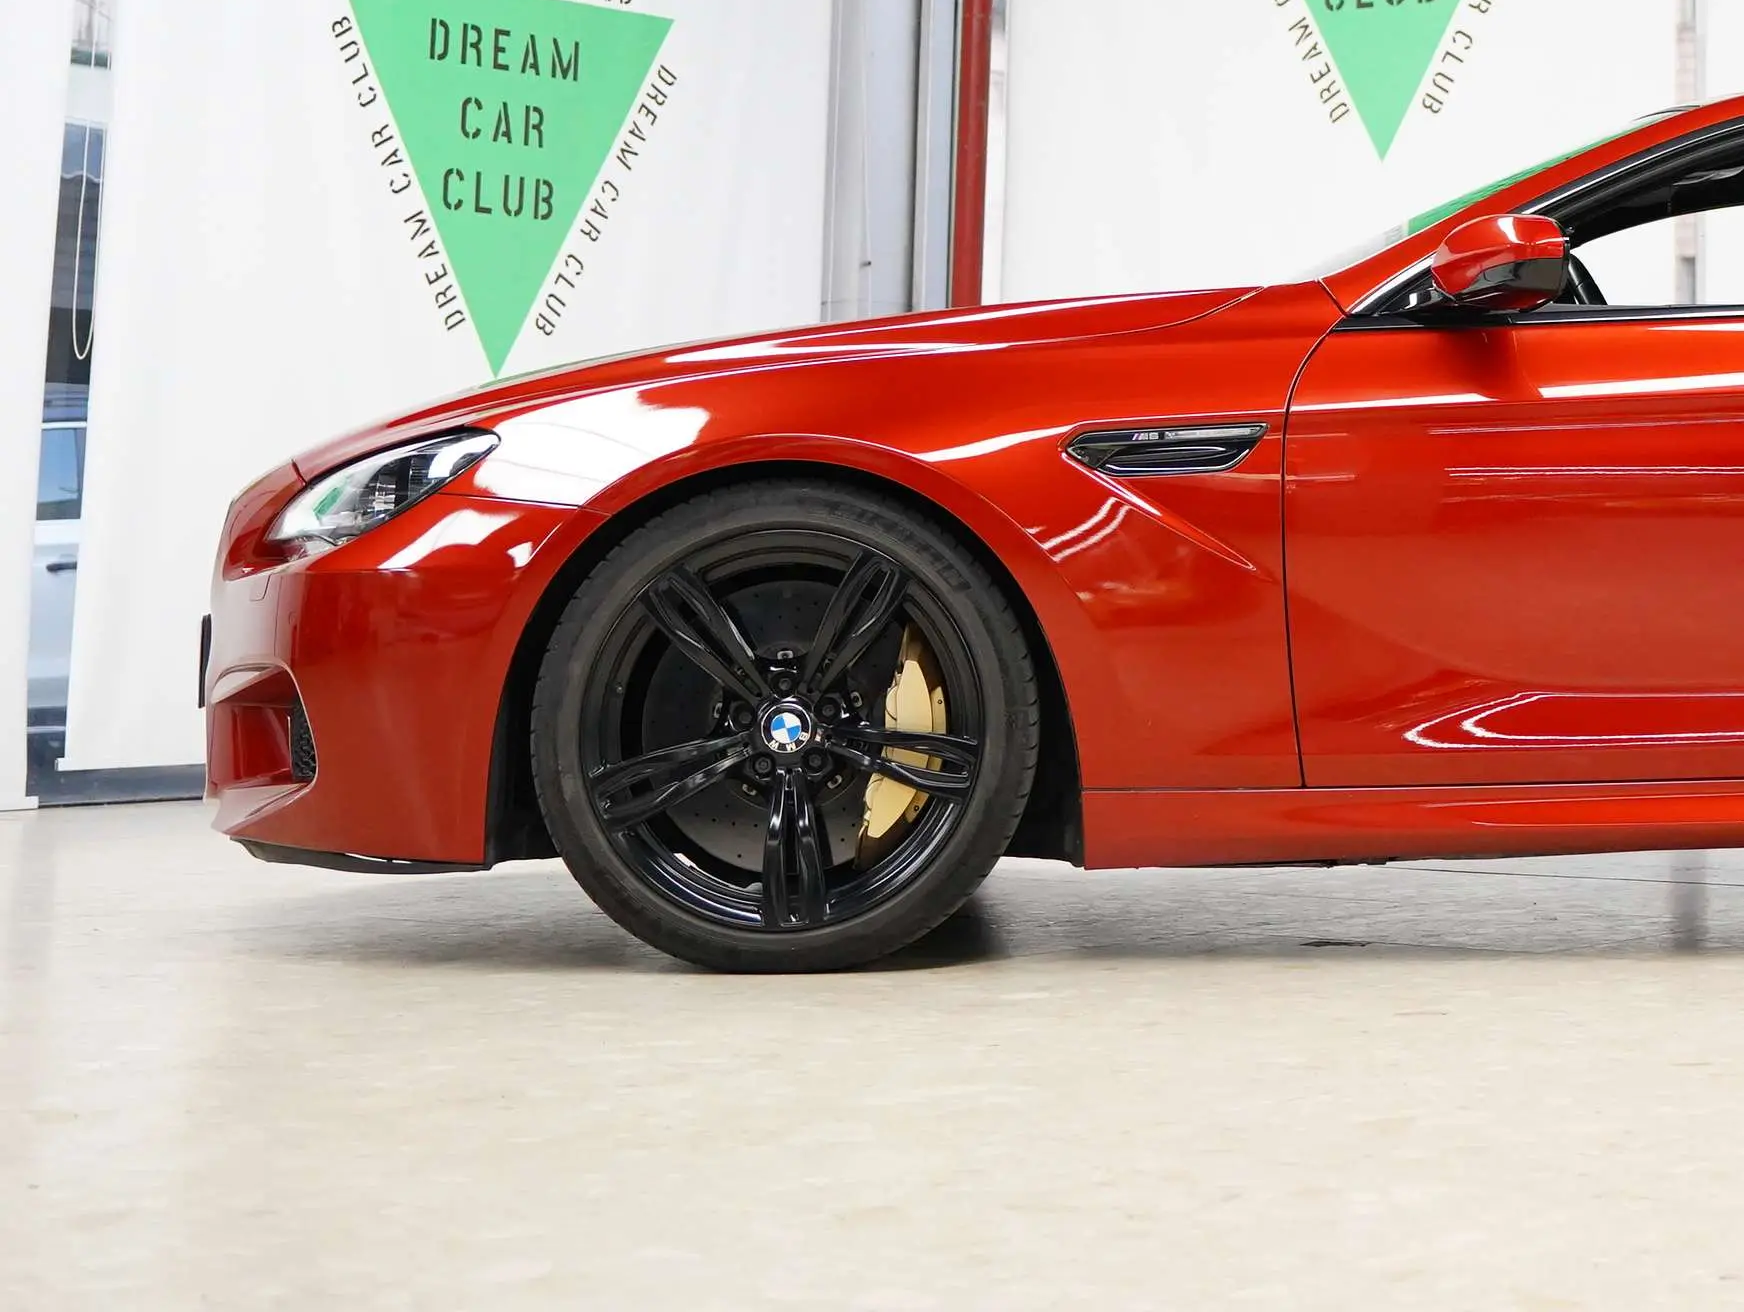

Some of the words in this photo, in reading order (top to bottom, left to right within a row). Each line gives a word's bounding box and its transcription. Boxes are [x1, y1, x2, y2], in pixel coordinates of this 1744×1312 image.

[332, 16, 376, 107] CLUB
[430, 18, 579, 81] DREAM
[1289, 17, 1349, 122] DREAM
[1423, 31, 1472, 113] CLUB
[372, 124, 411, 193] CAR
[461, 97, 544, 148] CAR
[617, 65, 677, 170] DREAM
[443, 168, 553, 220] CLUB
[580, 181, 618, 242] CAR
[404, 211, 465, 330] DREAM
[536, 254, 583, 336] CLUB
